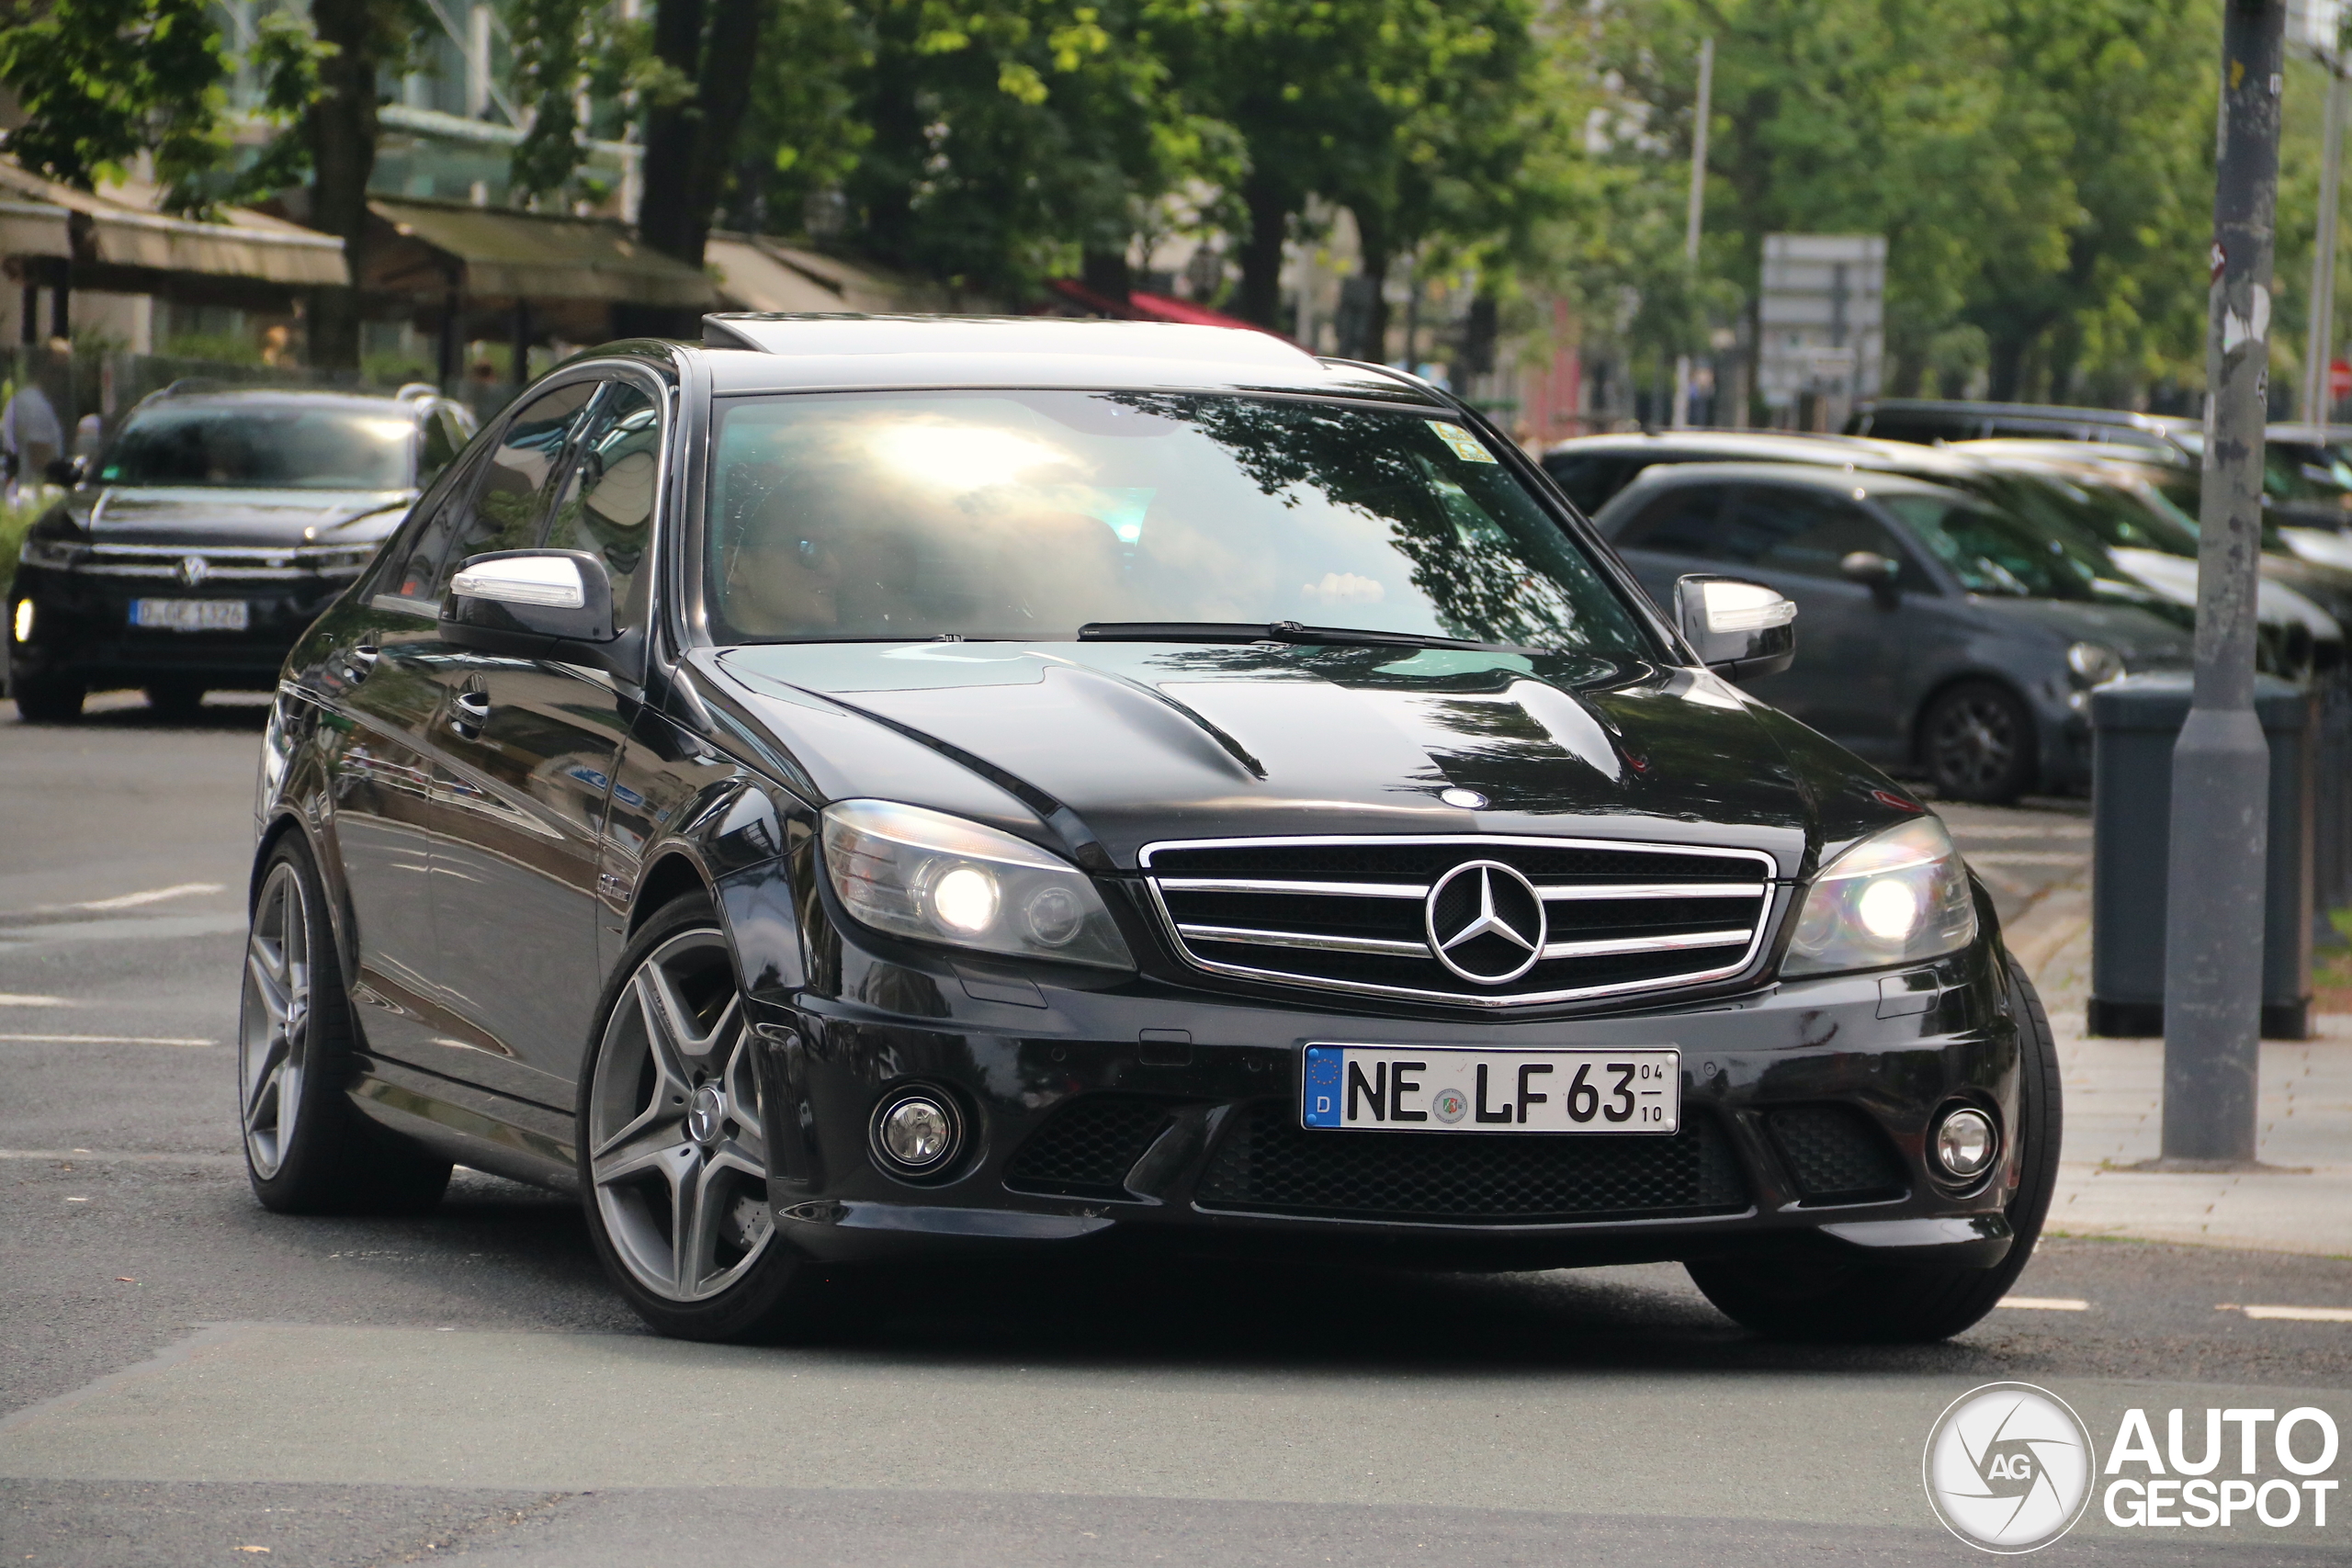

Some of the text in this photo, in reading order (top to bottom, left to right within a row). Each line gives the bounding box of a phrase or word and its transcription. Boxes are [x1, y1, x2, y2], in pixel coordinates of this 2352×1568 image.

[1641, 1064, 1663, 1079] 04
[1347, 1060, 1635, 1123] NE LF 63
[1317, 1096, 1330, 1112] D
[1642, 1106, 1662, 1122] 10
